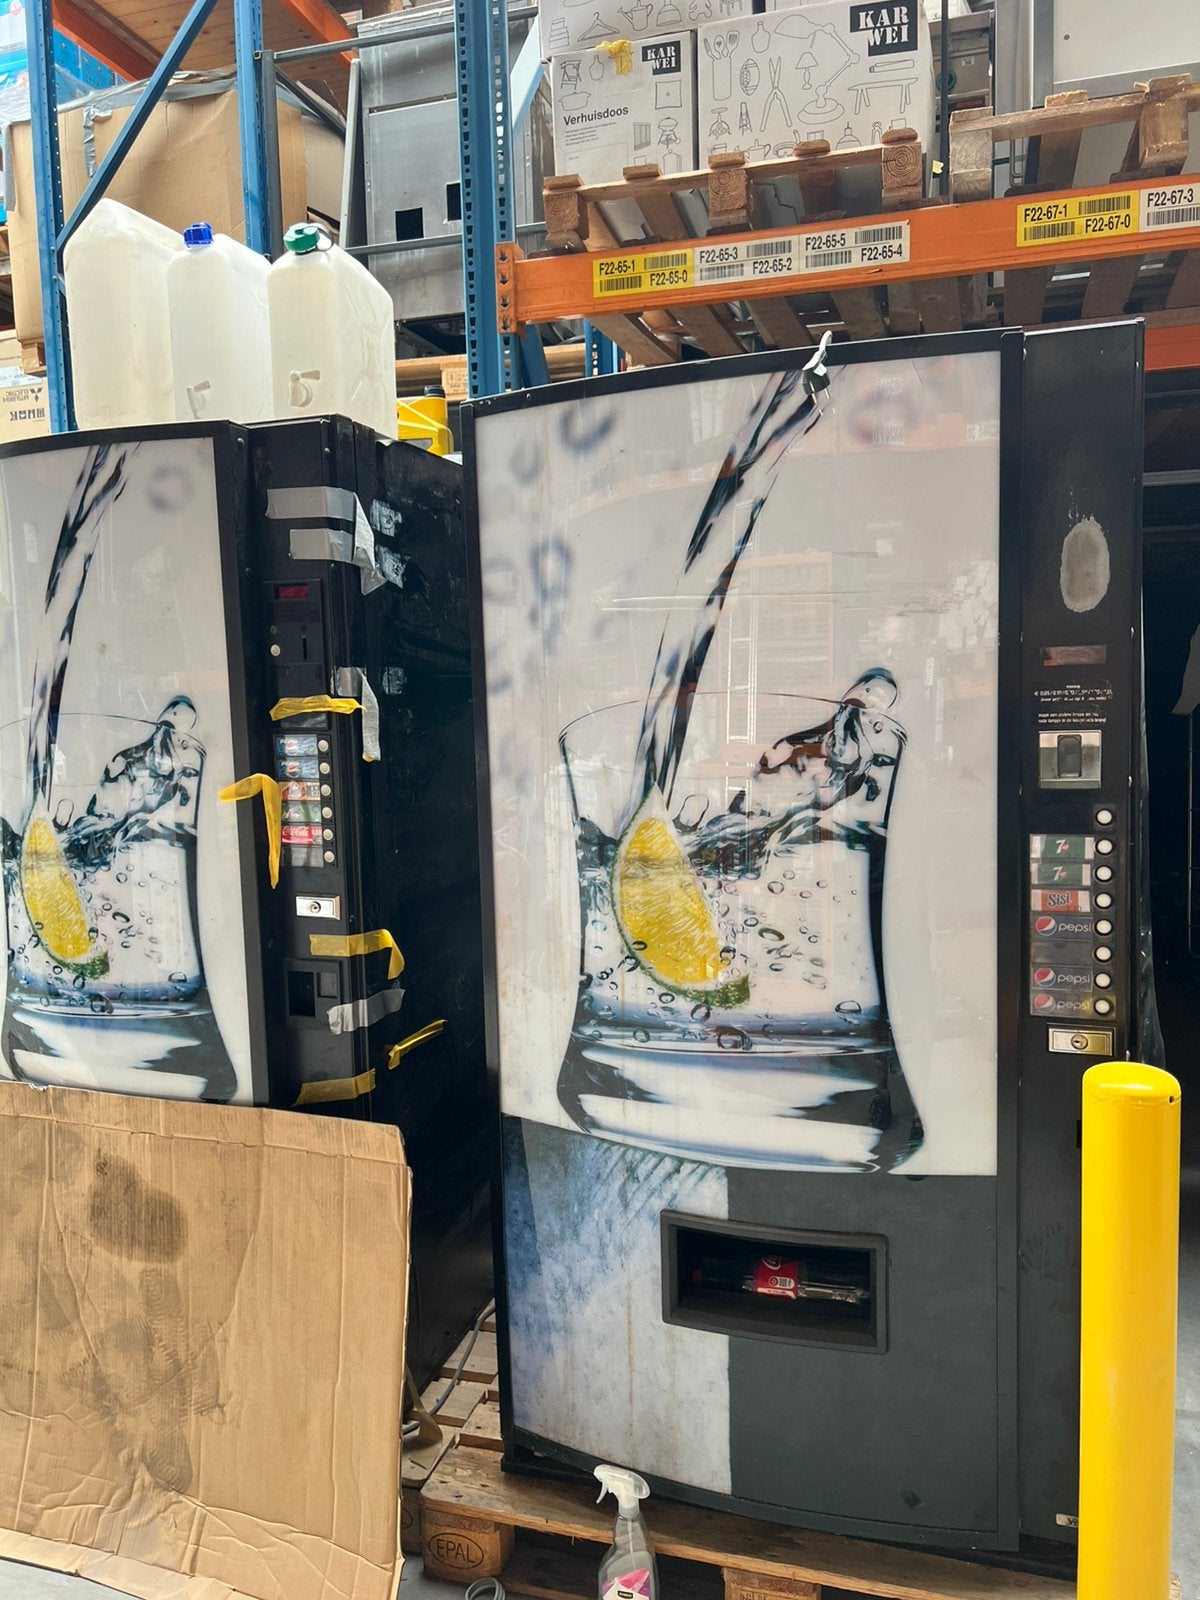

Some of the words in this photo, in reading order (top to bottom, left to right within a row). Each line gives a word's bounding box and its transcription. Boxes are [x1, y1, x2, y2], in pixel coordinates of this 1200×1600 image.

[858, 6, 909, 29] KAR
[868, 25, 909, 46] WEI
[647, 46, 676, 60] KAR
[652, 57, 676, 70] WEI
[563, 106, 629, 125] Verhuisdoos
[1147, 188, 1194, 208] F22-67-3
[1024, 203, 1068, 222] F22-67-1
[1085, 214, 1131, 233] F22-67-0
[805, 233, 846, 251] F22-65-5
[699, 247, 738, 264] F22-65-3
[861, 244, 903, 262] F22-65-4
[599, 259, 636, 276] F22-65-1
[752, 257, 792, 275] F22-65-2
[650, 269, 688, 287] F22-65-0
[1048, 891, 1071, 907] Sisi
[1058, 923, 1092, 933] pepsi
[1057, 974, 1090, 984] pepsi
[1056, 1000, 1090, 1010] pepsi
[436, 1538, 476, 1564] EPAL
